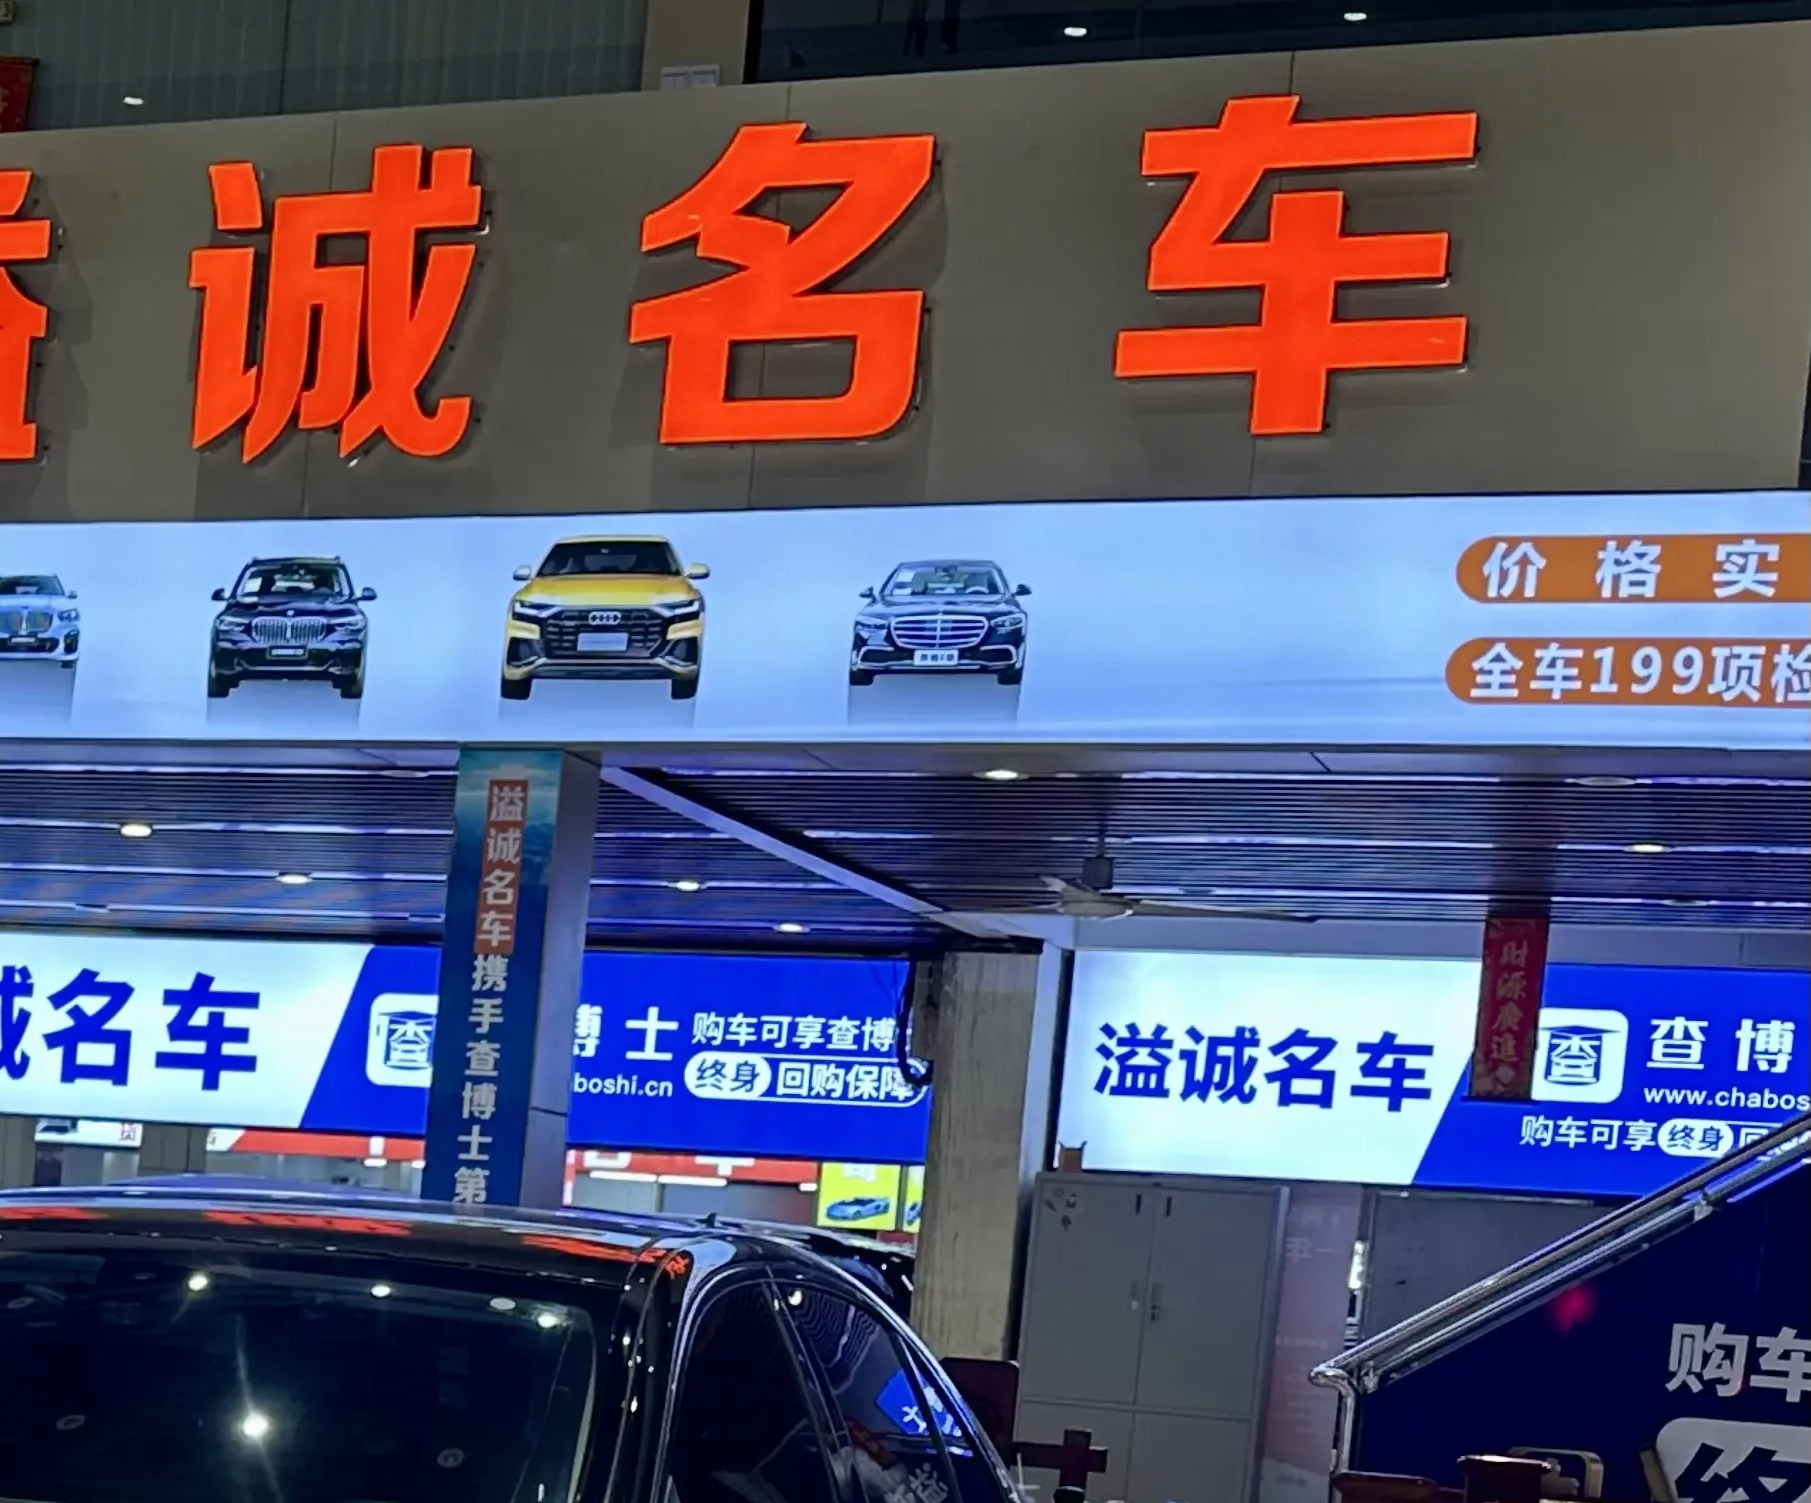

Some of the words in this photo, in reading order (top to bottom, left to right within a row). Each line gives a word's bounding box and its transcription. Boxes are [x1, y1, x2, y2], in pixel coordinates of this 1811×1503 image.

[1482, 538, 1781, 599] 价格实
[1469, 642, 1811, 704] 全车199项检
[452, 785, 525, 1205] 溢诚名车携手查博士第
[692, 1012, 902, 1053] 购车可享查博
[1646, 1016, 1795, 1074] 查博
[573, 1073, 674, 1098] boshi.cn
[694, 1058, 761, 1093] 终身
[776, 1063, 915, 1102] 回购保障
[1094, 1022, 1435, 1113] 溢诚名车
[1519, 1115, 1657, 1151] 购车可享
[1666, 1124, 1727, 1153] 终身
[1665, 1321, 1811, 1403] 购车
